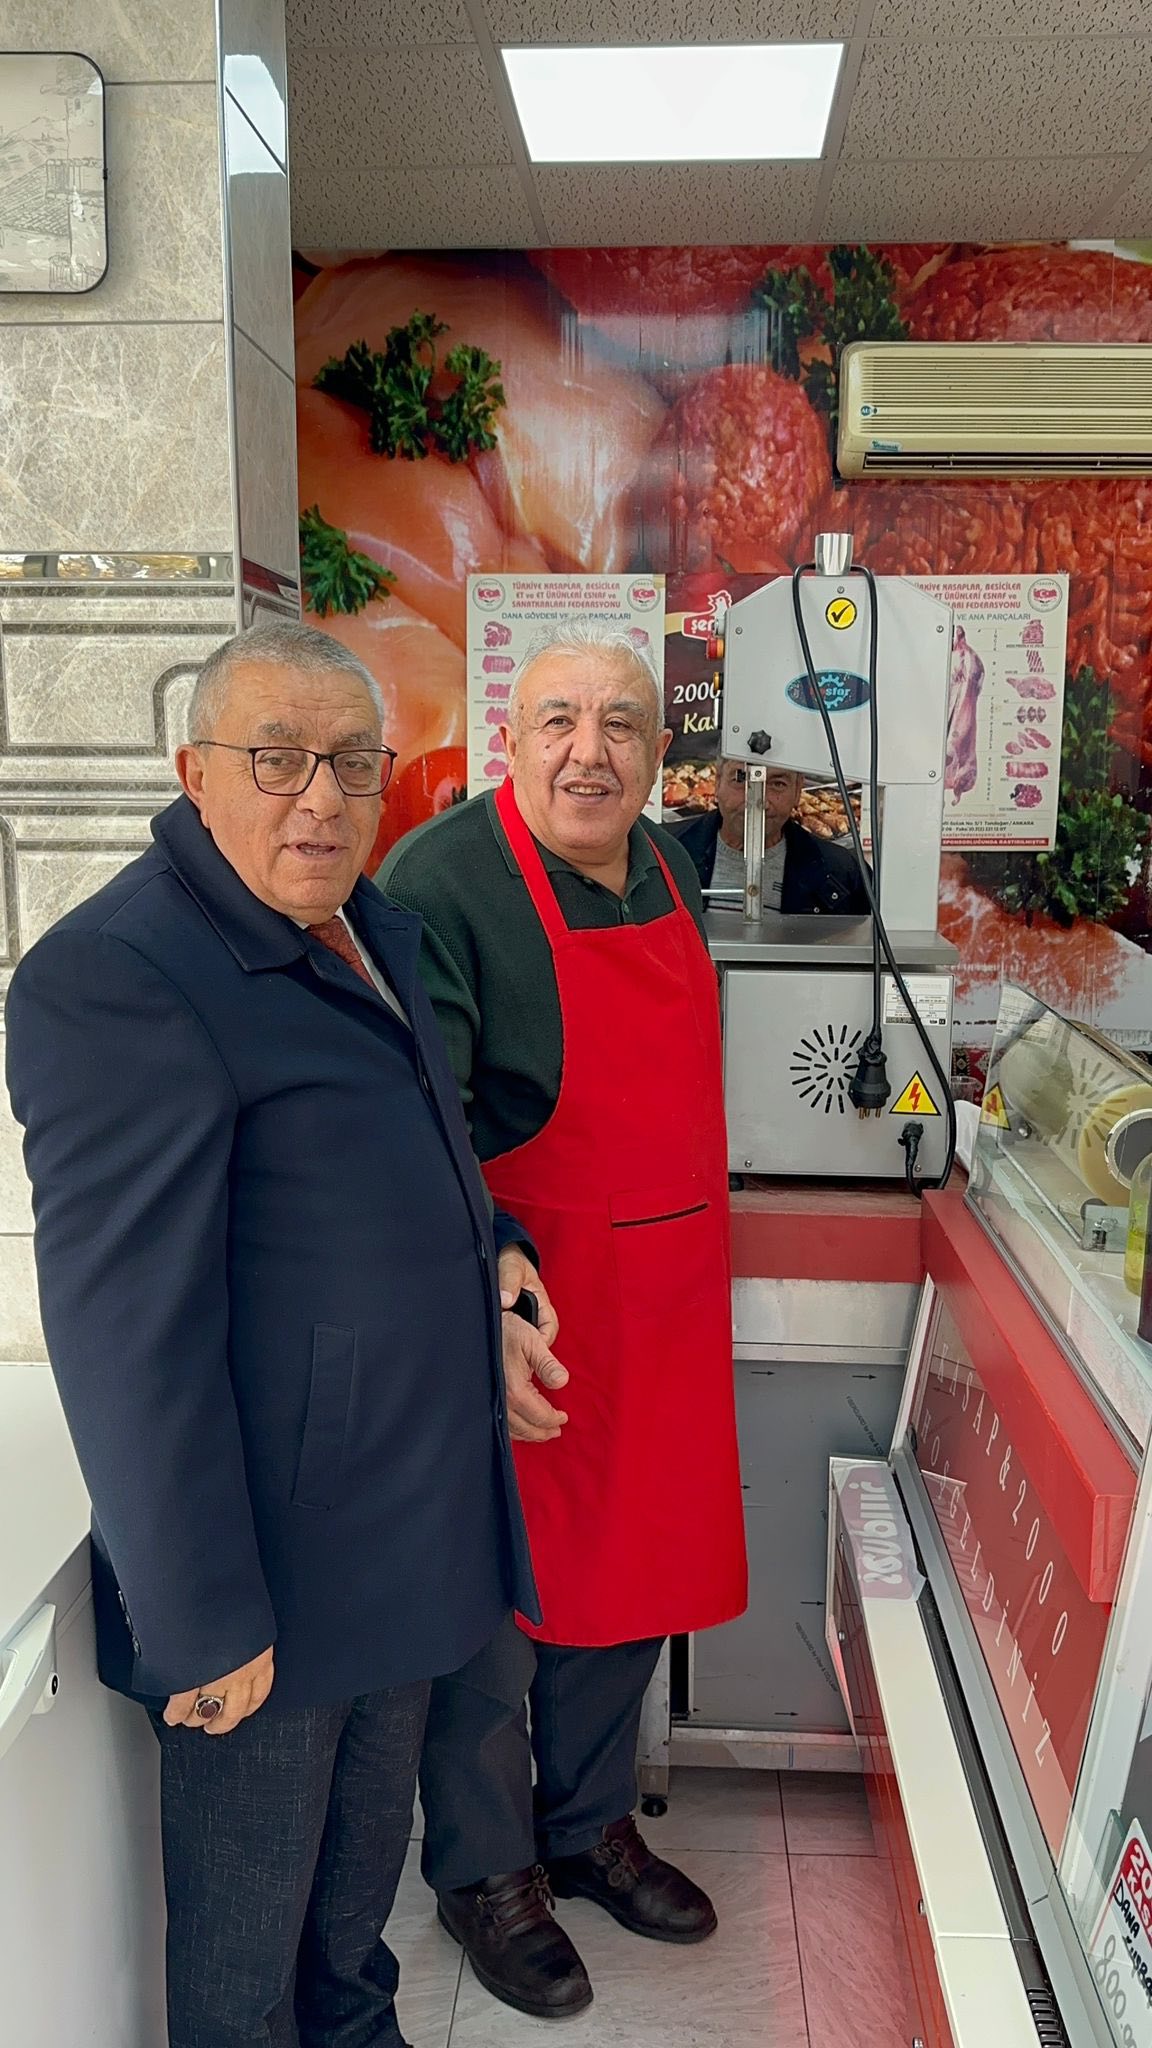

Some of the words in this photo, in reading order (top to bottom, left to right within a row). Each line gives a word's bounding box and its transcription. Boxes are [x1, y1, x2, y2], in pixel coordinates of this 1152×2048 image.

[512, 582, 542, 590] TÜRKİYE
[544, 582, 583, 591] KASAPLAR,
[586, 581, 620, 590] BESİCİLER
[943, 582, 982, 592] KASAPLAR,
[985, 581, 1021, 590] BESİCİLER
[546, 591, 582, 599] ÜRÜNLERİ
[944, 591, 981, 600] ÜRÜNLERİ
[983, 592, 1006, 600] ESNAF
[966, 601, 1021, 609] FEDERASYONU
[501, 612, 523, 620] DANA
[524, 611, 558, 620] GÖVDESİ
[588, 612, 631, 621] PARÇALARI
[987, 613, 1031, 621] PARÇALARI
[1127, 1868, 1152, 1938] KAS
[1113, 1878, 1140, 1939] DANA
